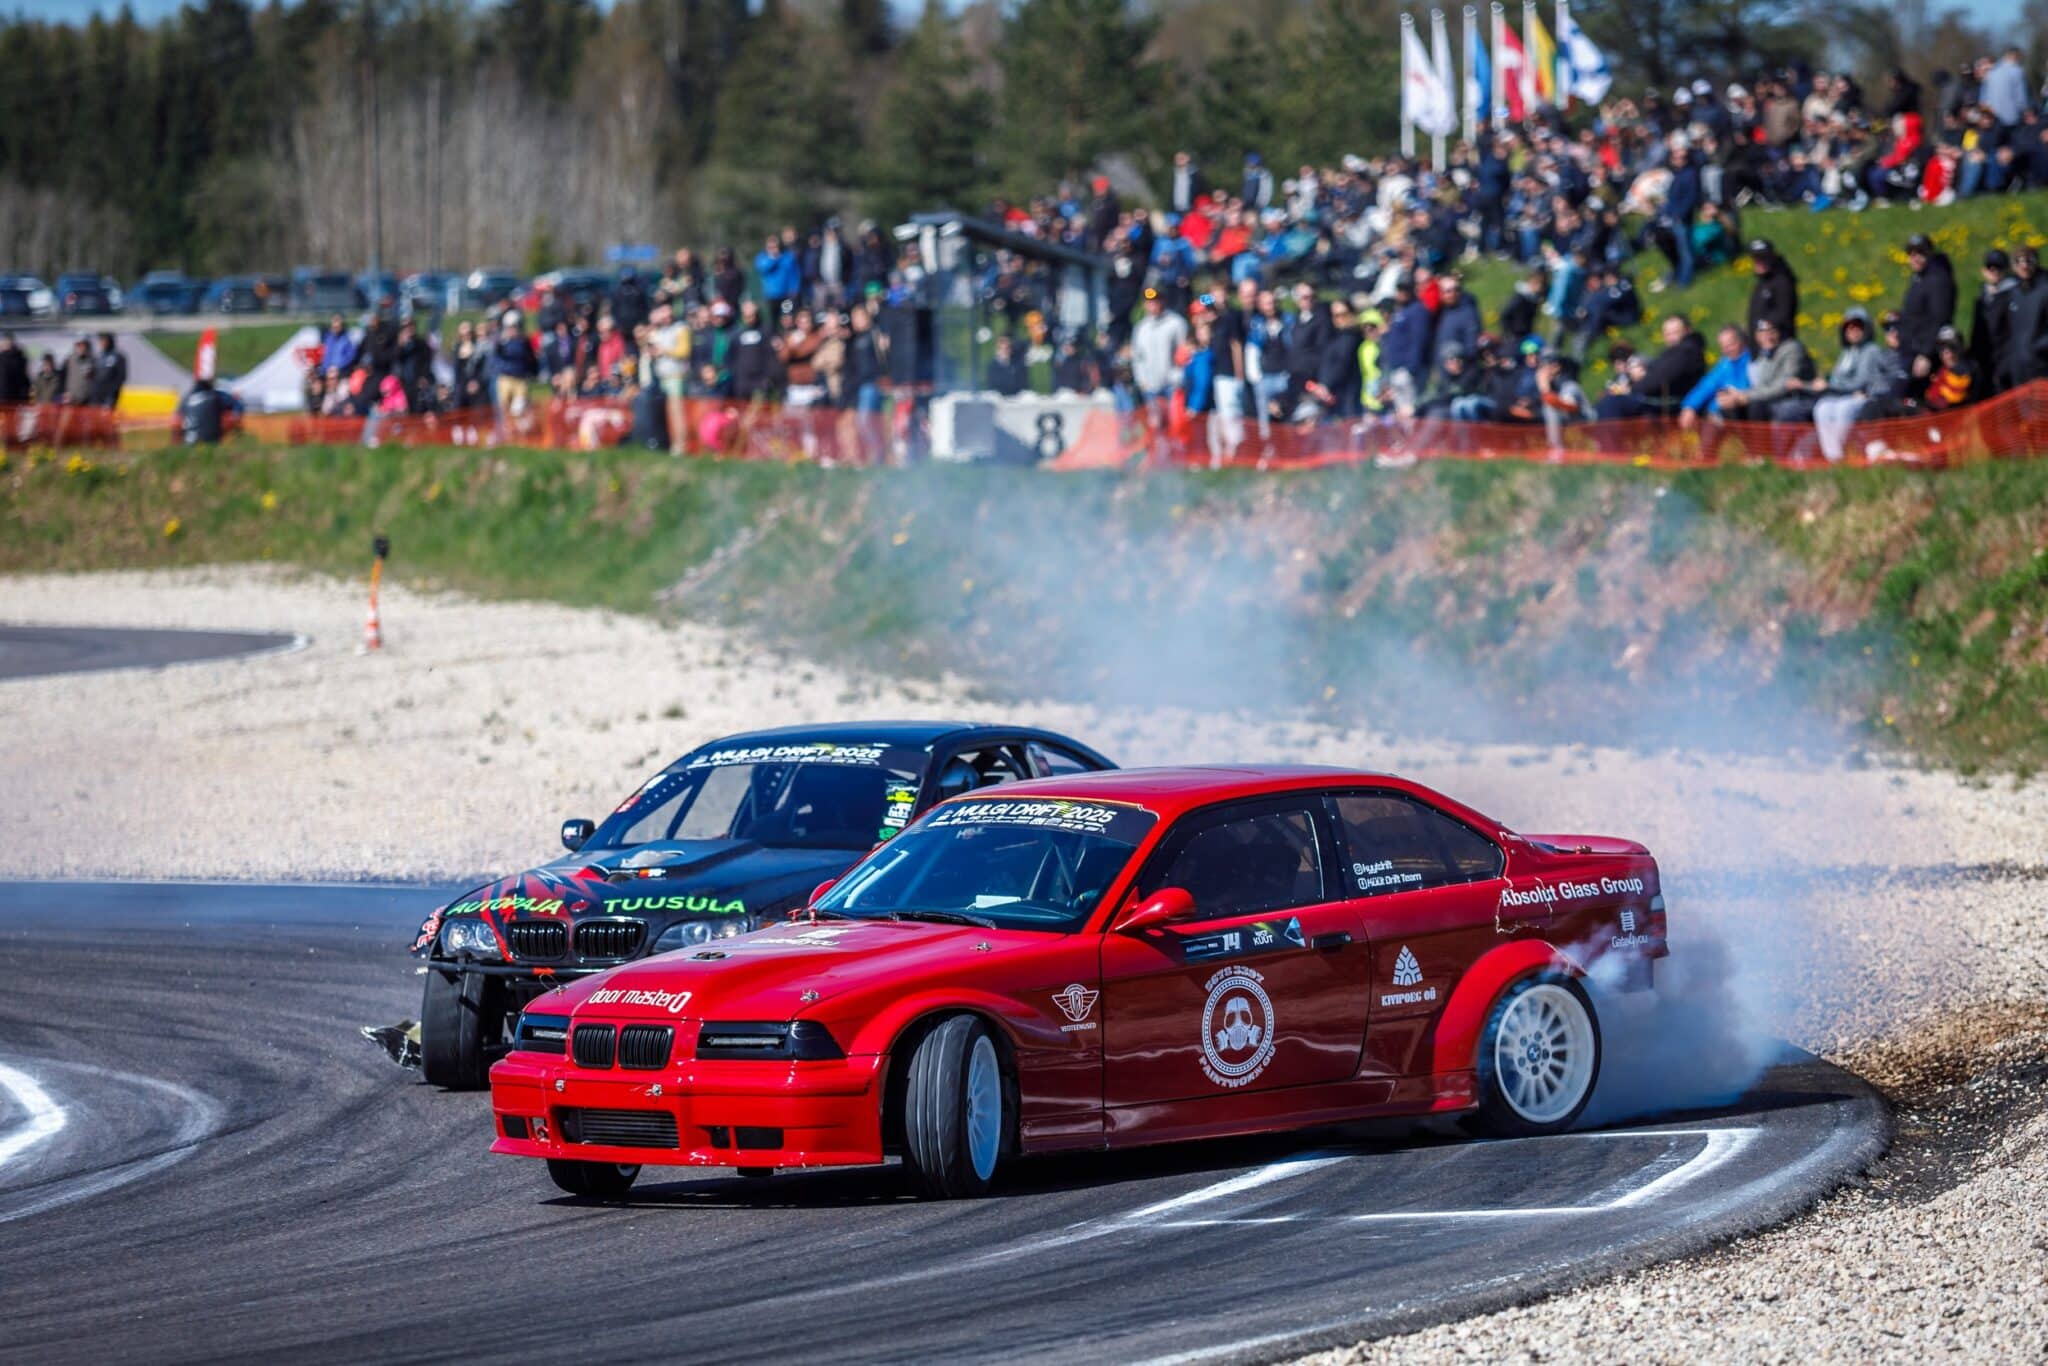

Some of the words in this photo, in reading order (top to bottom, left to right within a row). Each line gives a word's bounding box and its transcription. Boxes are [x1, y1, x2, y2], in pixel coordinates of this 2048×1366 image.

[1037, 411, 1064, 458] 8
[711, 746, 773, 761] MULGI
[774, 744, 833, 757] DRIFT
[833, 746, 884, 758] 2025
[952, 802, 1011, 817] MULGI
[1011, 802, 1065, 816] DRIFT
[1063, 806, 1119, 823] 2025
[1385, 874, 1400, 885] Drift
[1400, 872, 1422, 883] Team
[1501, 885, 1559, 907] Absolut
[1559, 881, 1600, 900] Glass
[1600, 877, 1644, 895] Group
[446, 893, 566, 916] AUTOPAJA
[603, 895, 747, 914] TUUSULA
[1223, 931, 1241, 951] 14
[588, 987, 627, 1004] door
